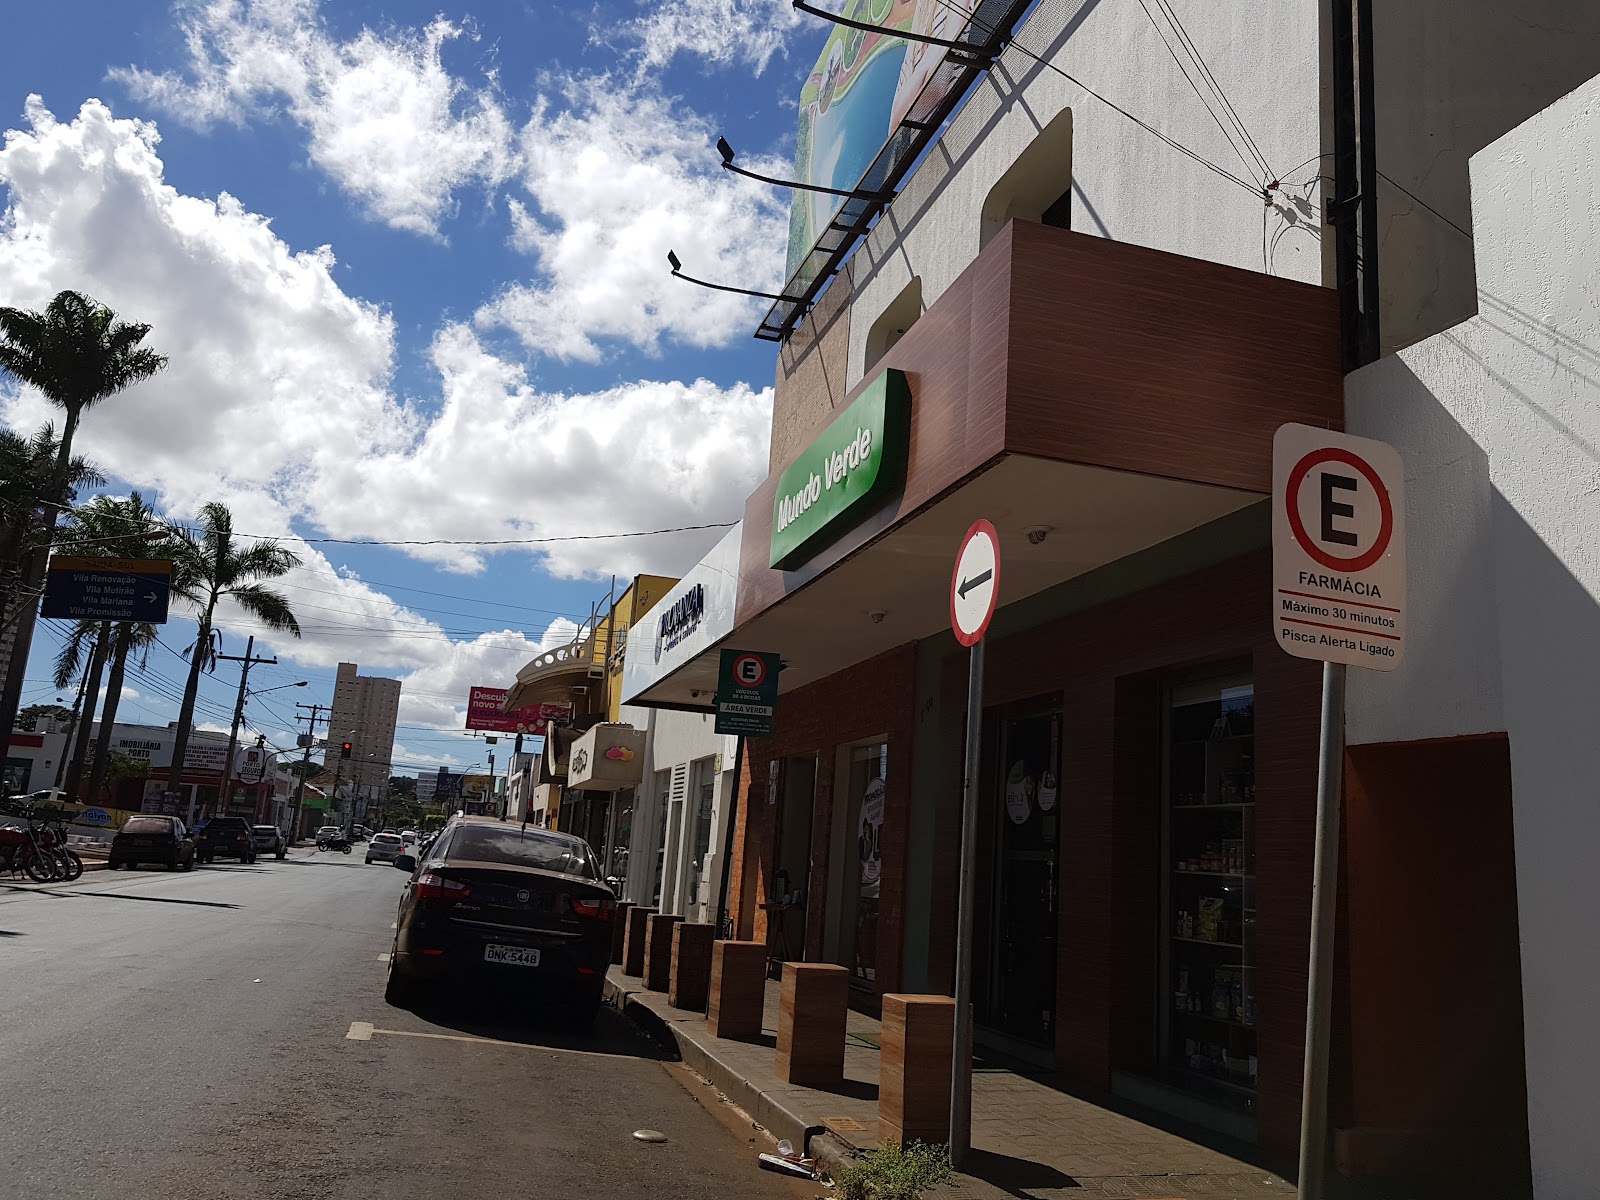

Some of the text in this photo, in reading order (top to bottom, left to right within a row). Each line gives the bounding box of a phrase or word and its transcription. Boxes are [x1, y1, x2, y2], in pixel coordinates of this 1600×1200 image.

[778, 427, 872, 533] Mundo Verde
[1321, 472, 1358, 547] E
[73, 574, 136, 585] Vila Renovação
[1299, 572, 1382, 598] FARMÁCIA
[85, 585, 135, 595] Vila Mutirão
[83, 596, 133, 606] Vila Mariana
[69, 606, 132, 617] Vila Promissão
[1282, 599, 1395, 628] Máximo 30 minutos
[1282, 629, 1395, 657] Pisca Alerta Ligado
[743, 661, 757, 679] E
[473, 701, 495, 709] novo
[725, 703, 768, 714] ÁREA VERDE
[480, 709, 503, 717] cada
[120, 740, 161, 750] IMOBILIÁRIA
[128, 749, 150, 758] PORTO
